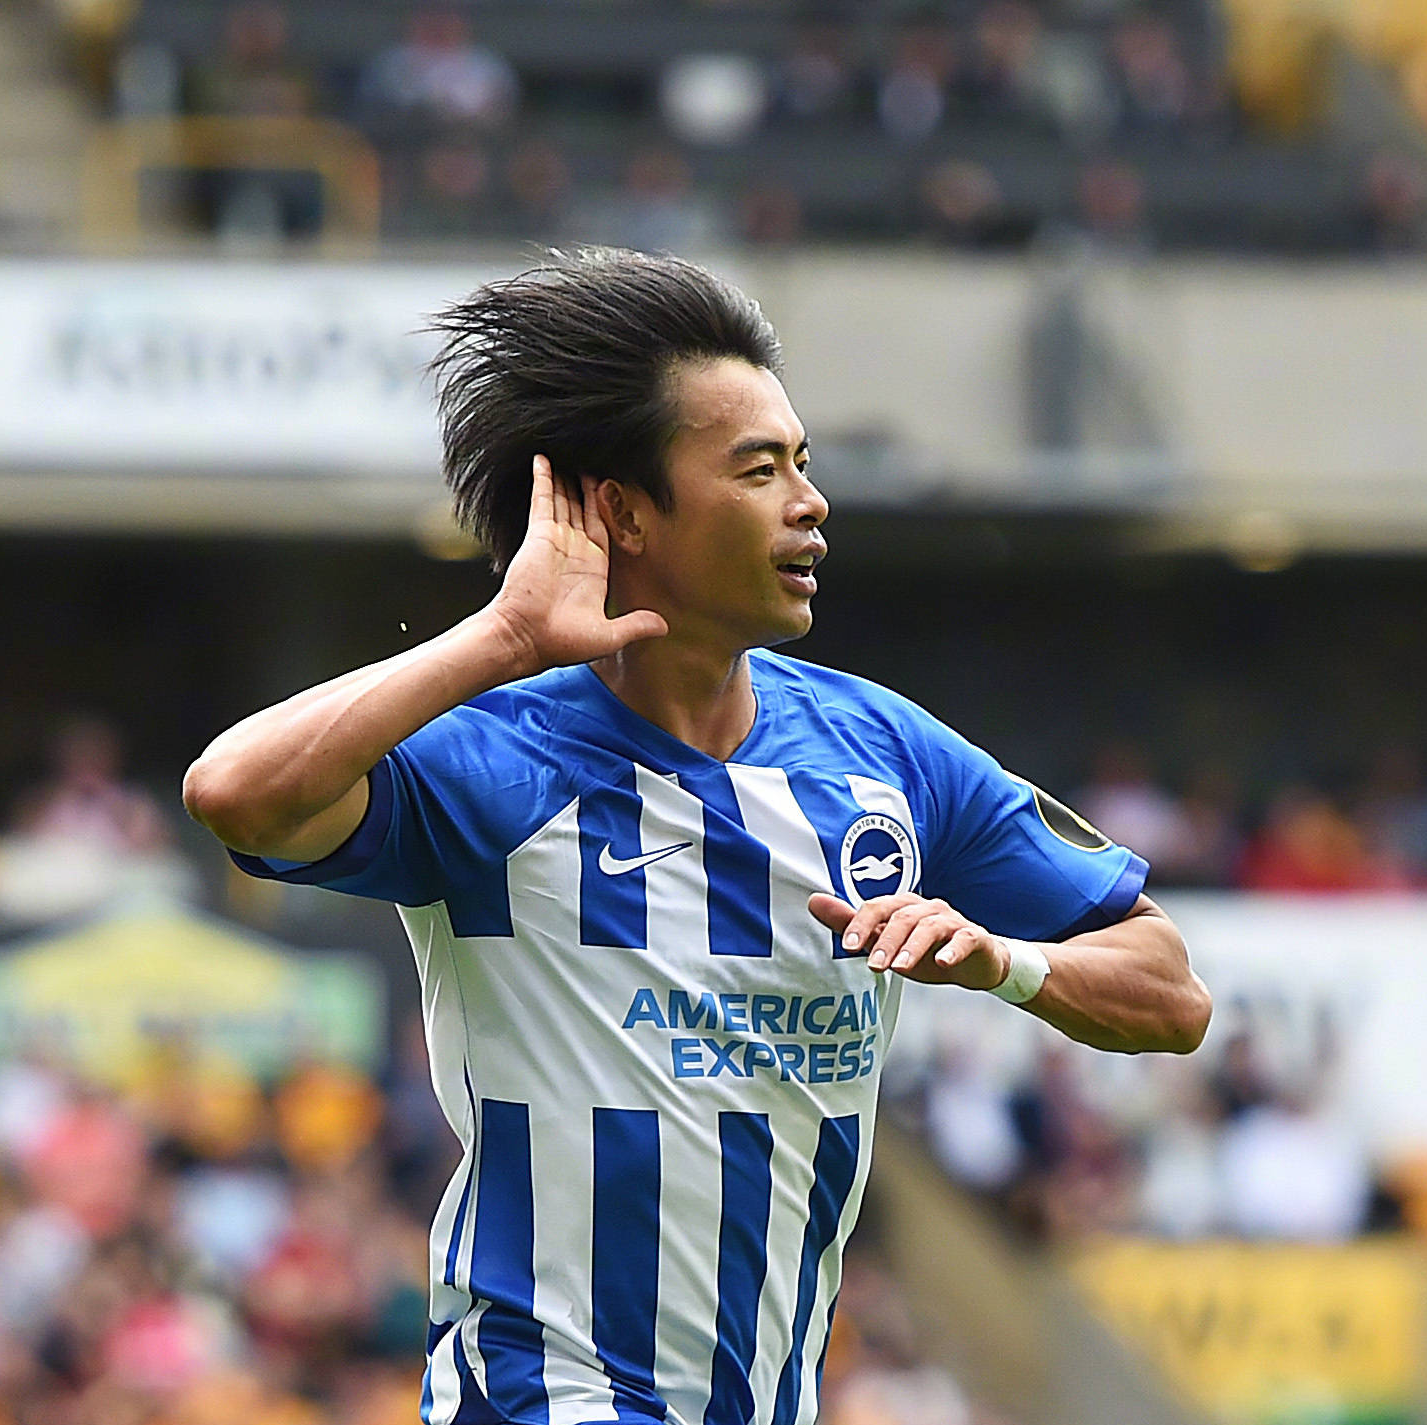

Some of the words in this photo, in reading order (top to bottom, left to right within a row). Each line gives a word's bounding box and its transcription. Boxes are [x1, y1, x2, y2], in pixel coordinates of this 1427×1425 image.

[845, 818, 876, 848] BRIGHTON
[879, 818, 885, 827] &
[887, 822, 906, 842] HOVE
[621, 986, 878, 1035] AMERICAN
[670, 1034, 876, 1084] EXPRESS
